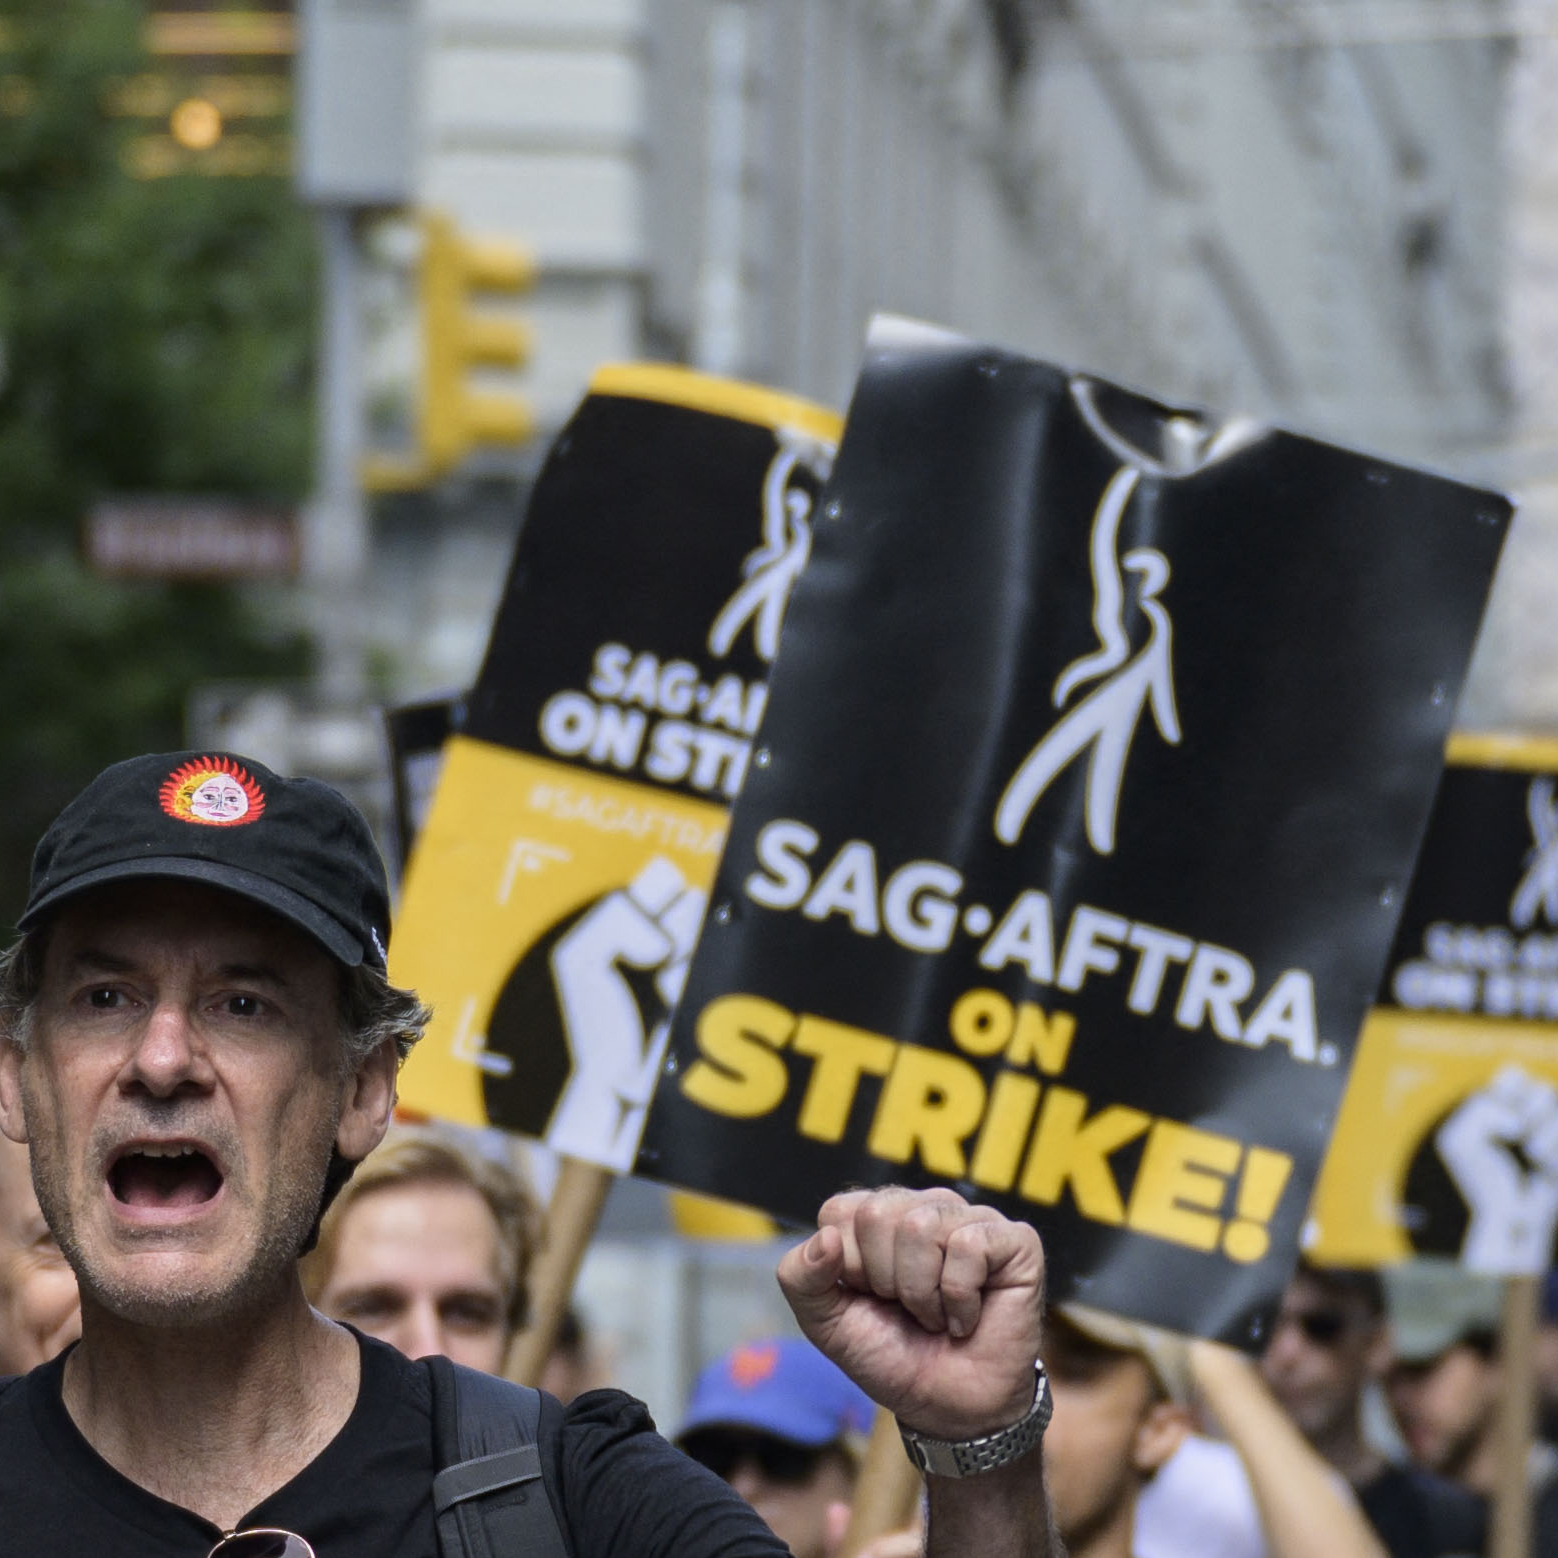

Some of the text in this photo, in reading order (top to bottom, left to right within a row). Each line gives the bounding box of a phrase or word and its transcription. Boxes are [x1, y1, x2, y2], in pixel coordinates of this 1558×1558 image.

[539, 690, 647, 770] ON
[949, 988, 1077, 1075] ON
[681, 994, 1293, 1264] STRIKE!
